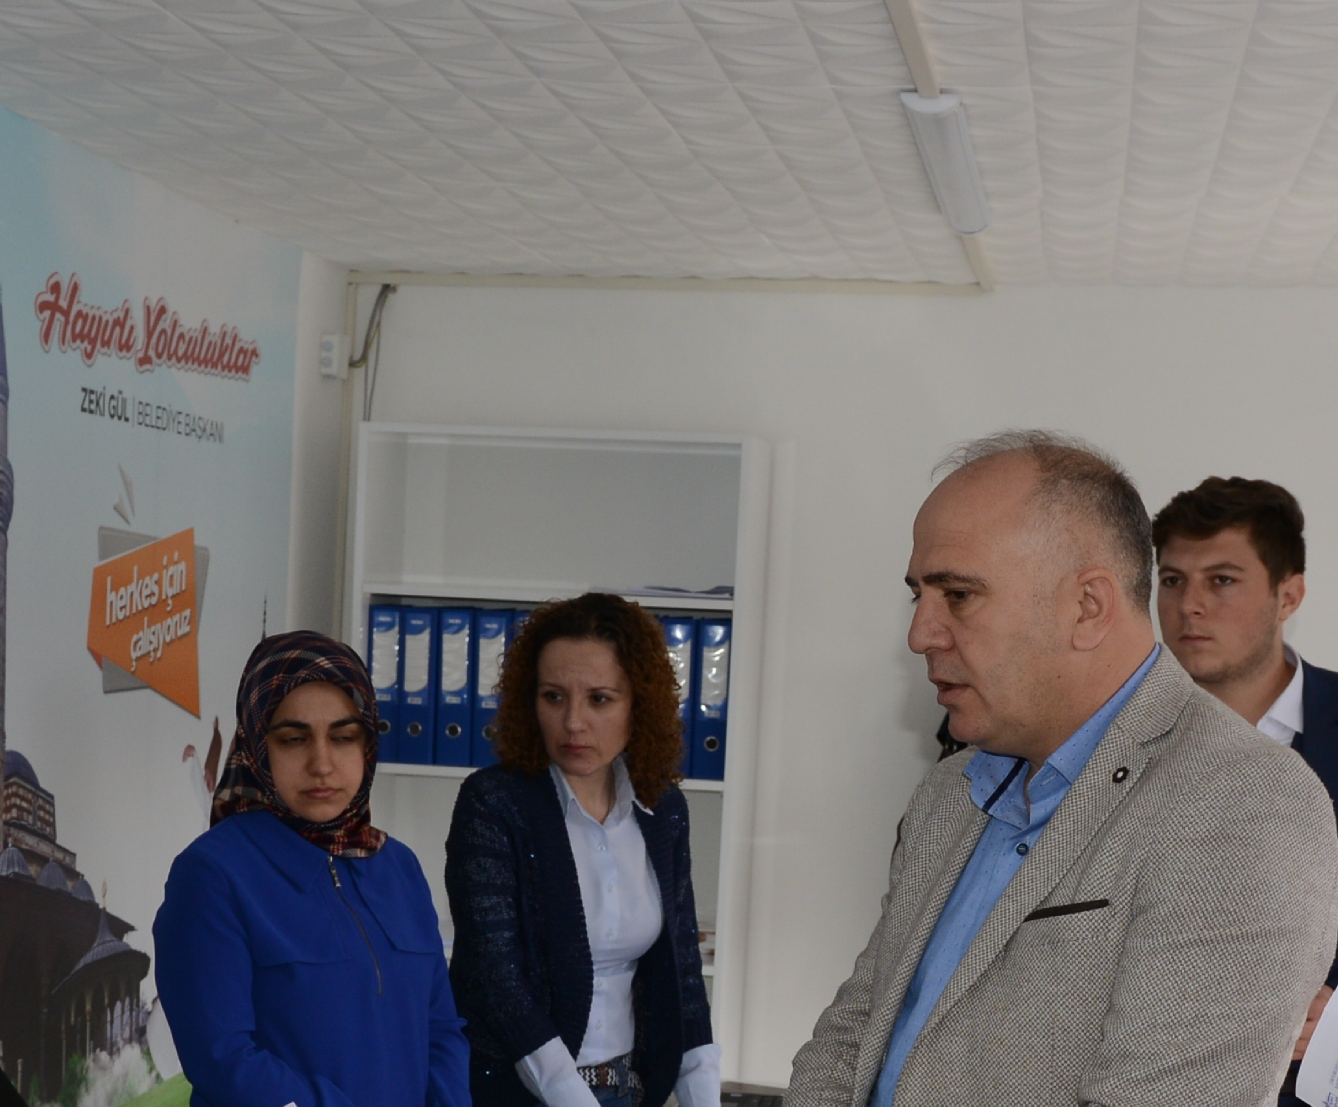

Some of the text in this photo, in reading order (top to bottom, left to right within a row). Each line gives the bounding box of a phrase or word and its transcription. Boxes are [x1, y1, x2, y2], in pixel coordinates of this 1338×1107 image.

[36, 274, 260, 379] Hayırlı Yolculuklar
[80, 386, 106, 417] ZEKİ
[108, 389, 130, 423] GÜL
[106, 551, 187, 627] herkes için
[130, 607, 191, 671] çalışıyoruz
